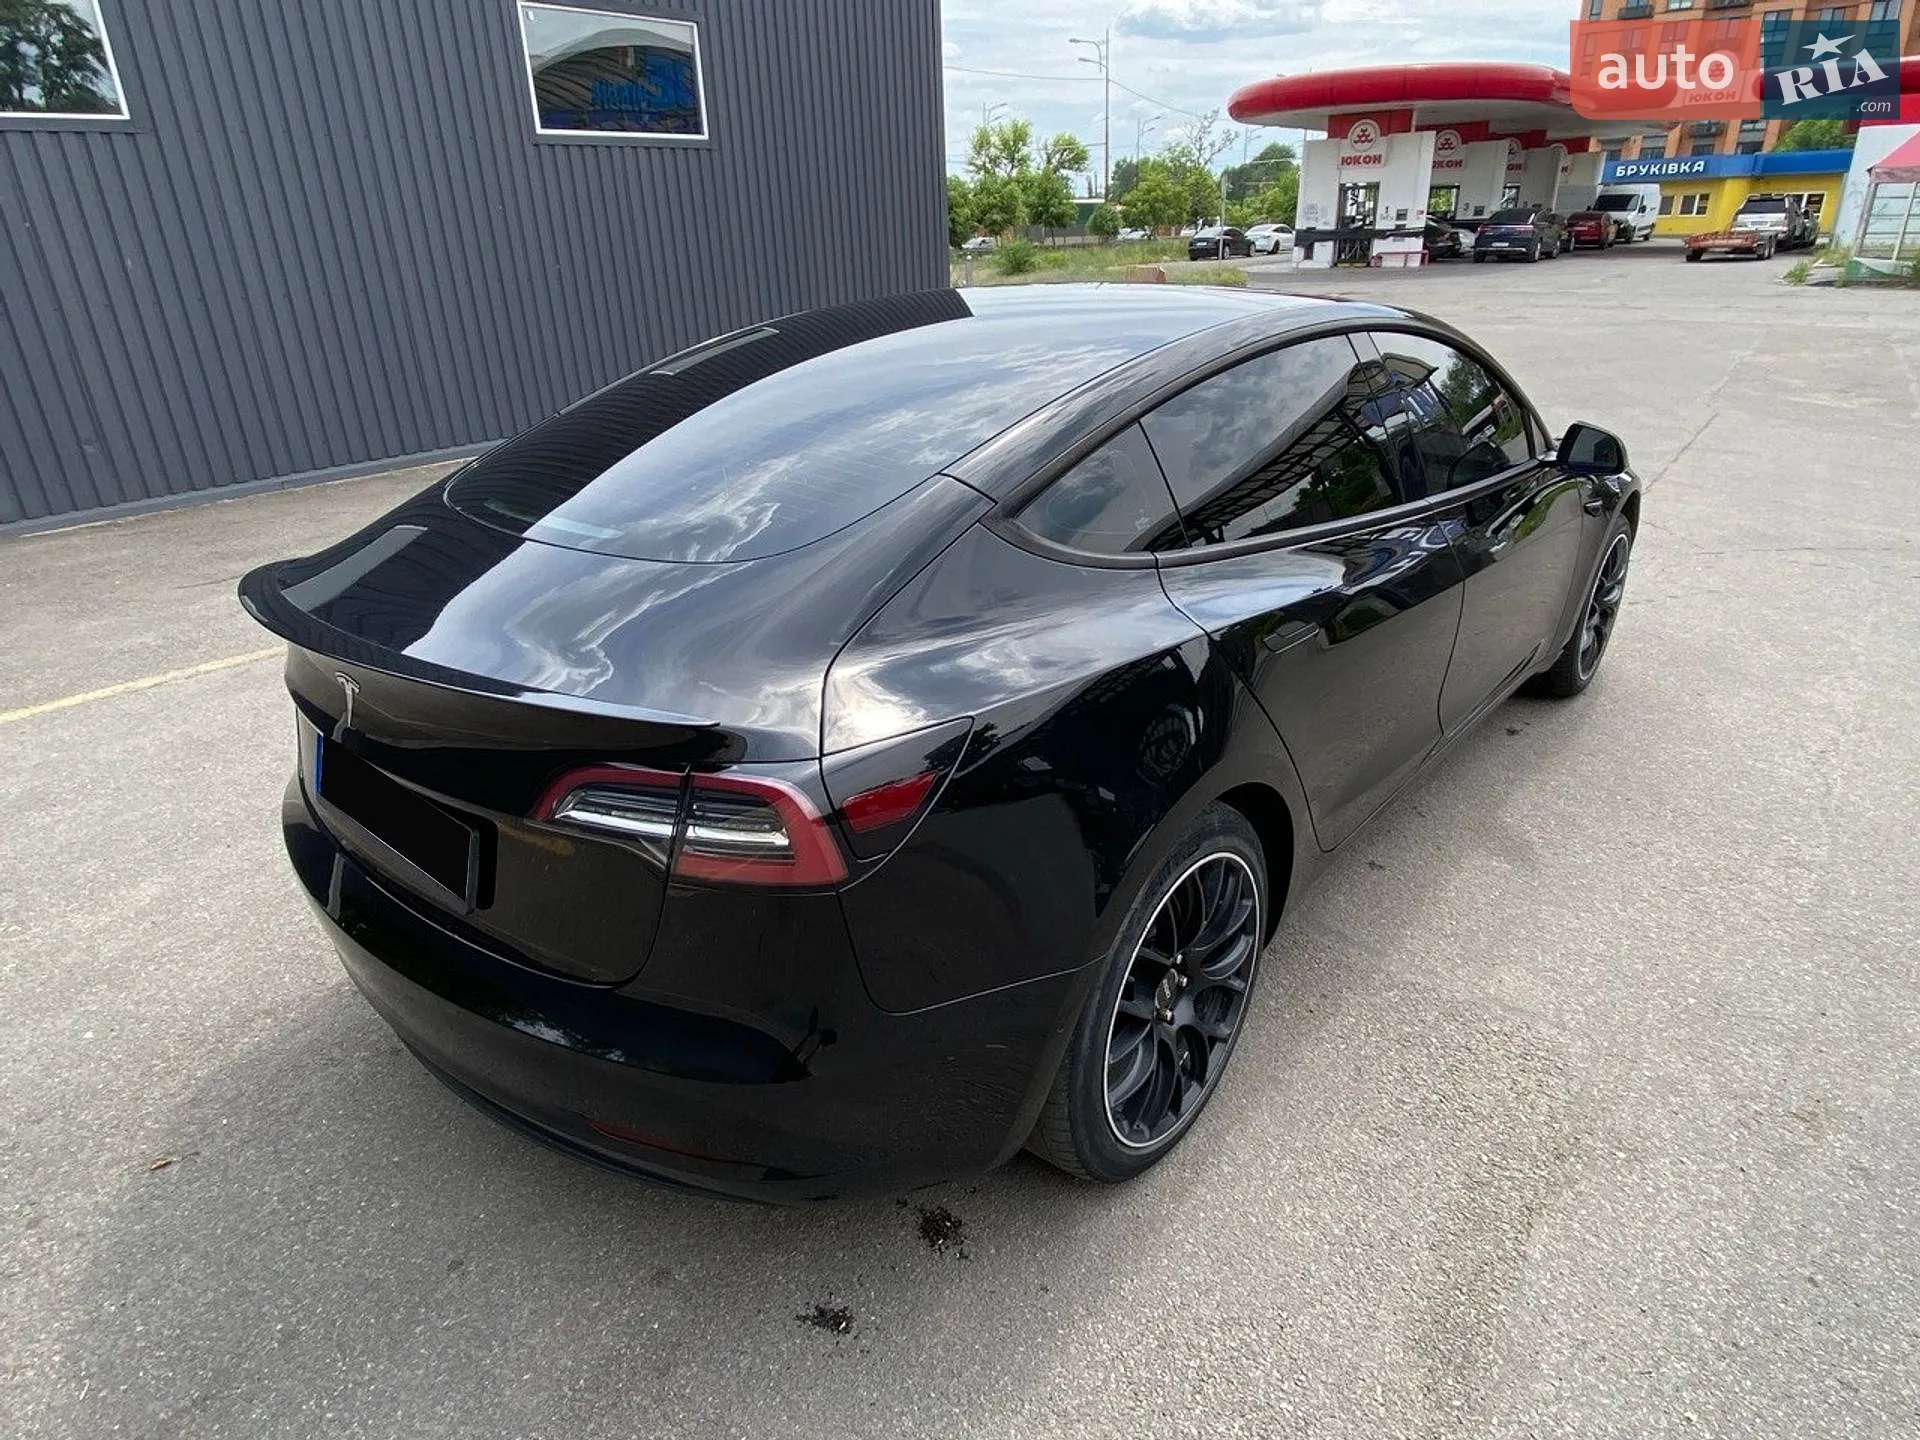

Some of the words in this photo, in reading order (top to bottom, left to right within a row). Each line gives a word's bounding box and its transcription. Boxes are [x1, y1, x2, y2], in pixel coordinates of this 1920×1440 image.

[1688, 90, 1736, 104] ЮКОН
[1341, 154, 1383, 166] ЮКОН
[1616, 160, 1705, 177] БРУКІВКА
